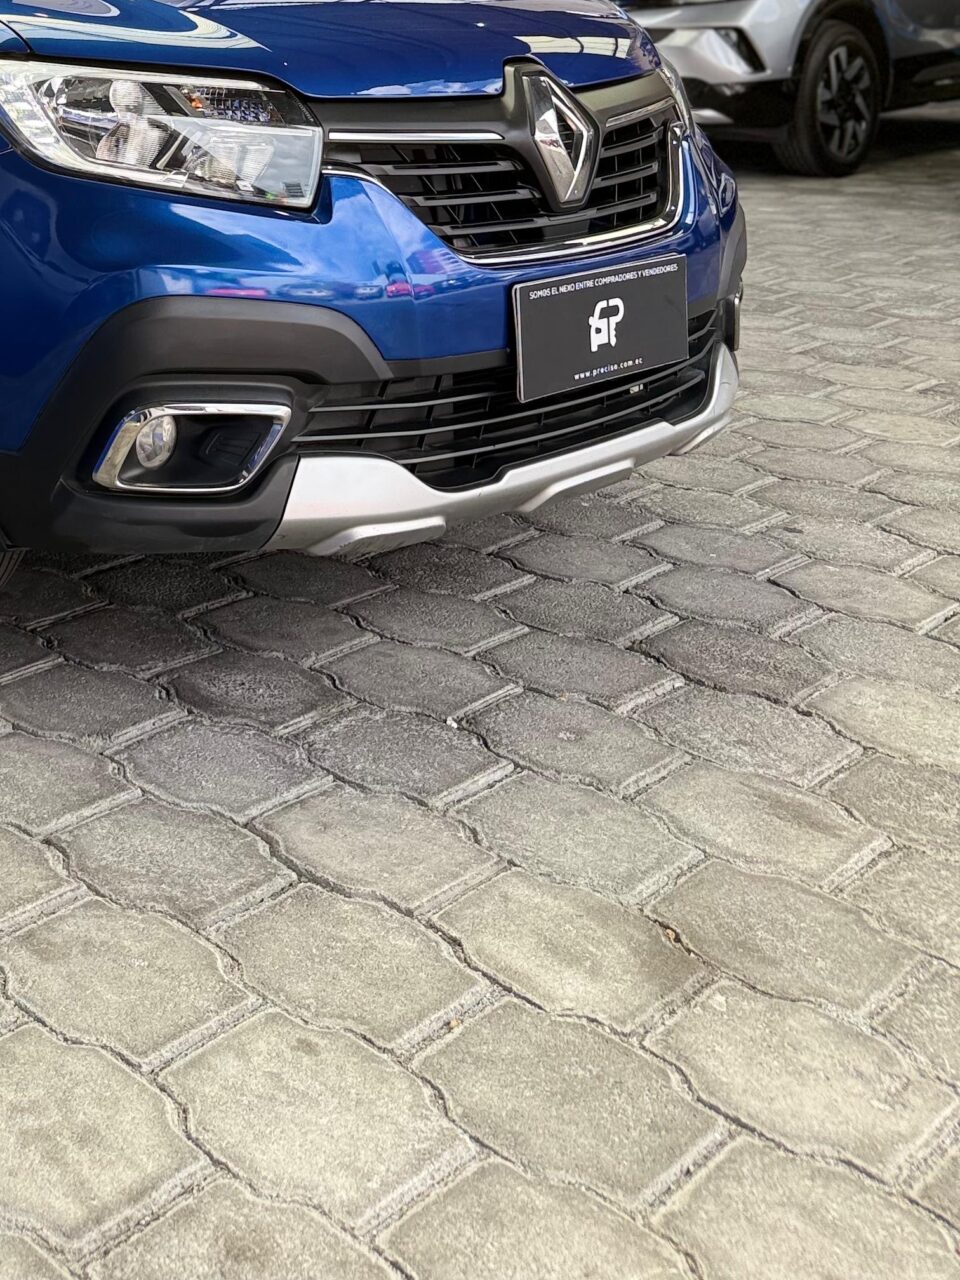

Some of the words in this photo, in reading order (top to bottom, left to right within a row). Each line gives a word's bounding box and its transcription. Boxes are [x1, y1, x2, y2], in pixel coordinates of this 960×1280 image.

[529, 287, 551, 300] SOMOS
[551, 286, 559, 295] EL
[559, 283, 575, 294] NEXO
[575, 279, 594, 290] ENTRE
[594, 272, 638, 287] COMPRADORES
[642, 263, 678, 277] VENDEDORES
[573, 357, 643, 380] www.preciso.com.ec
